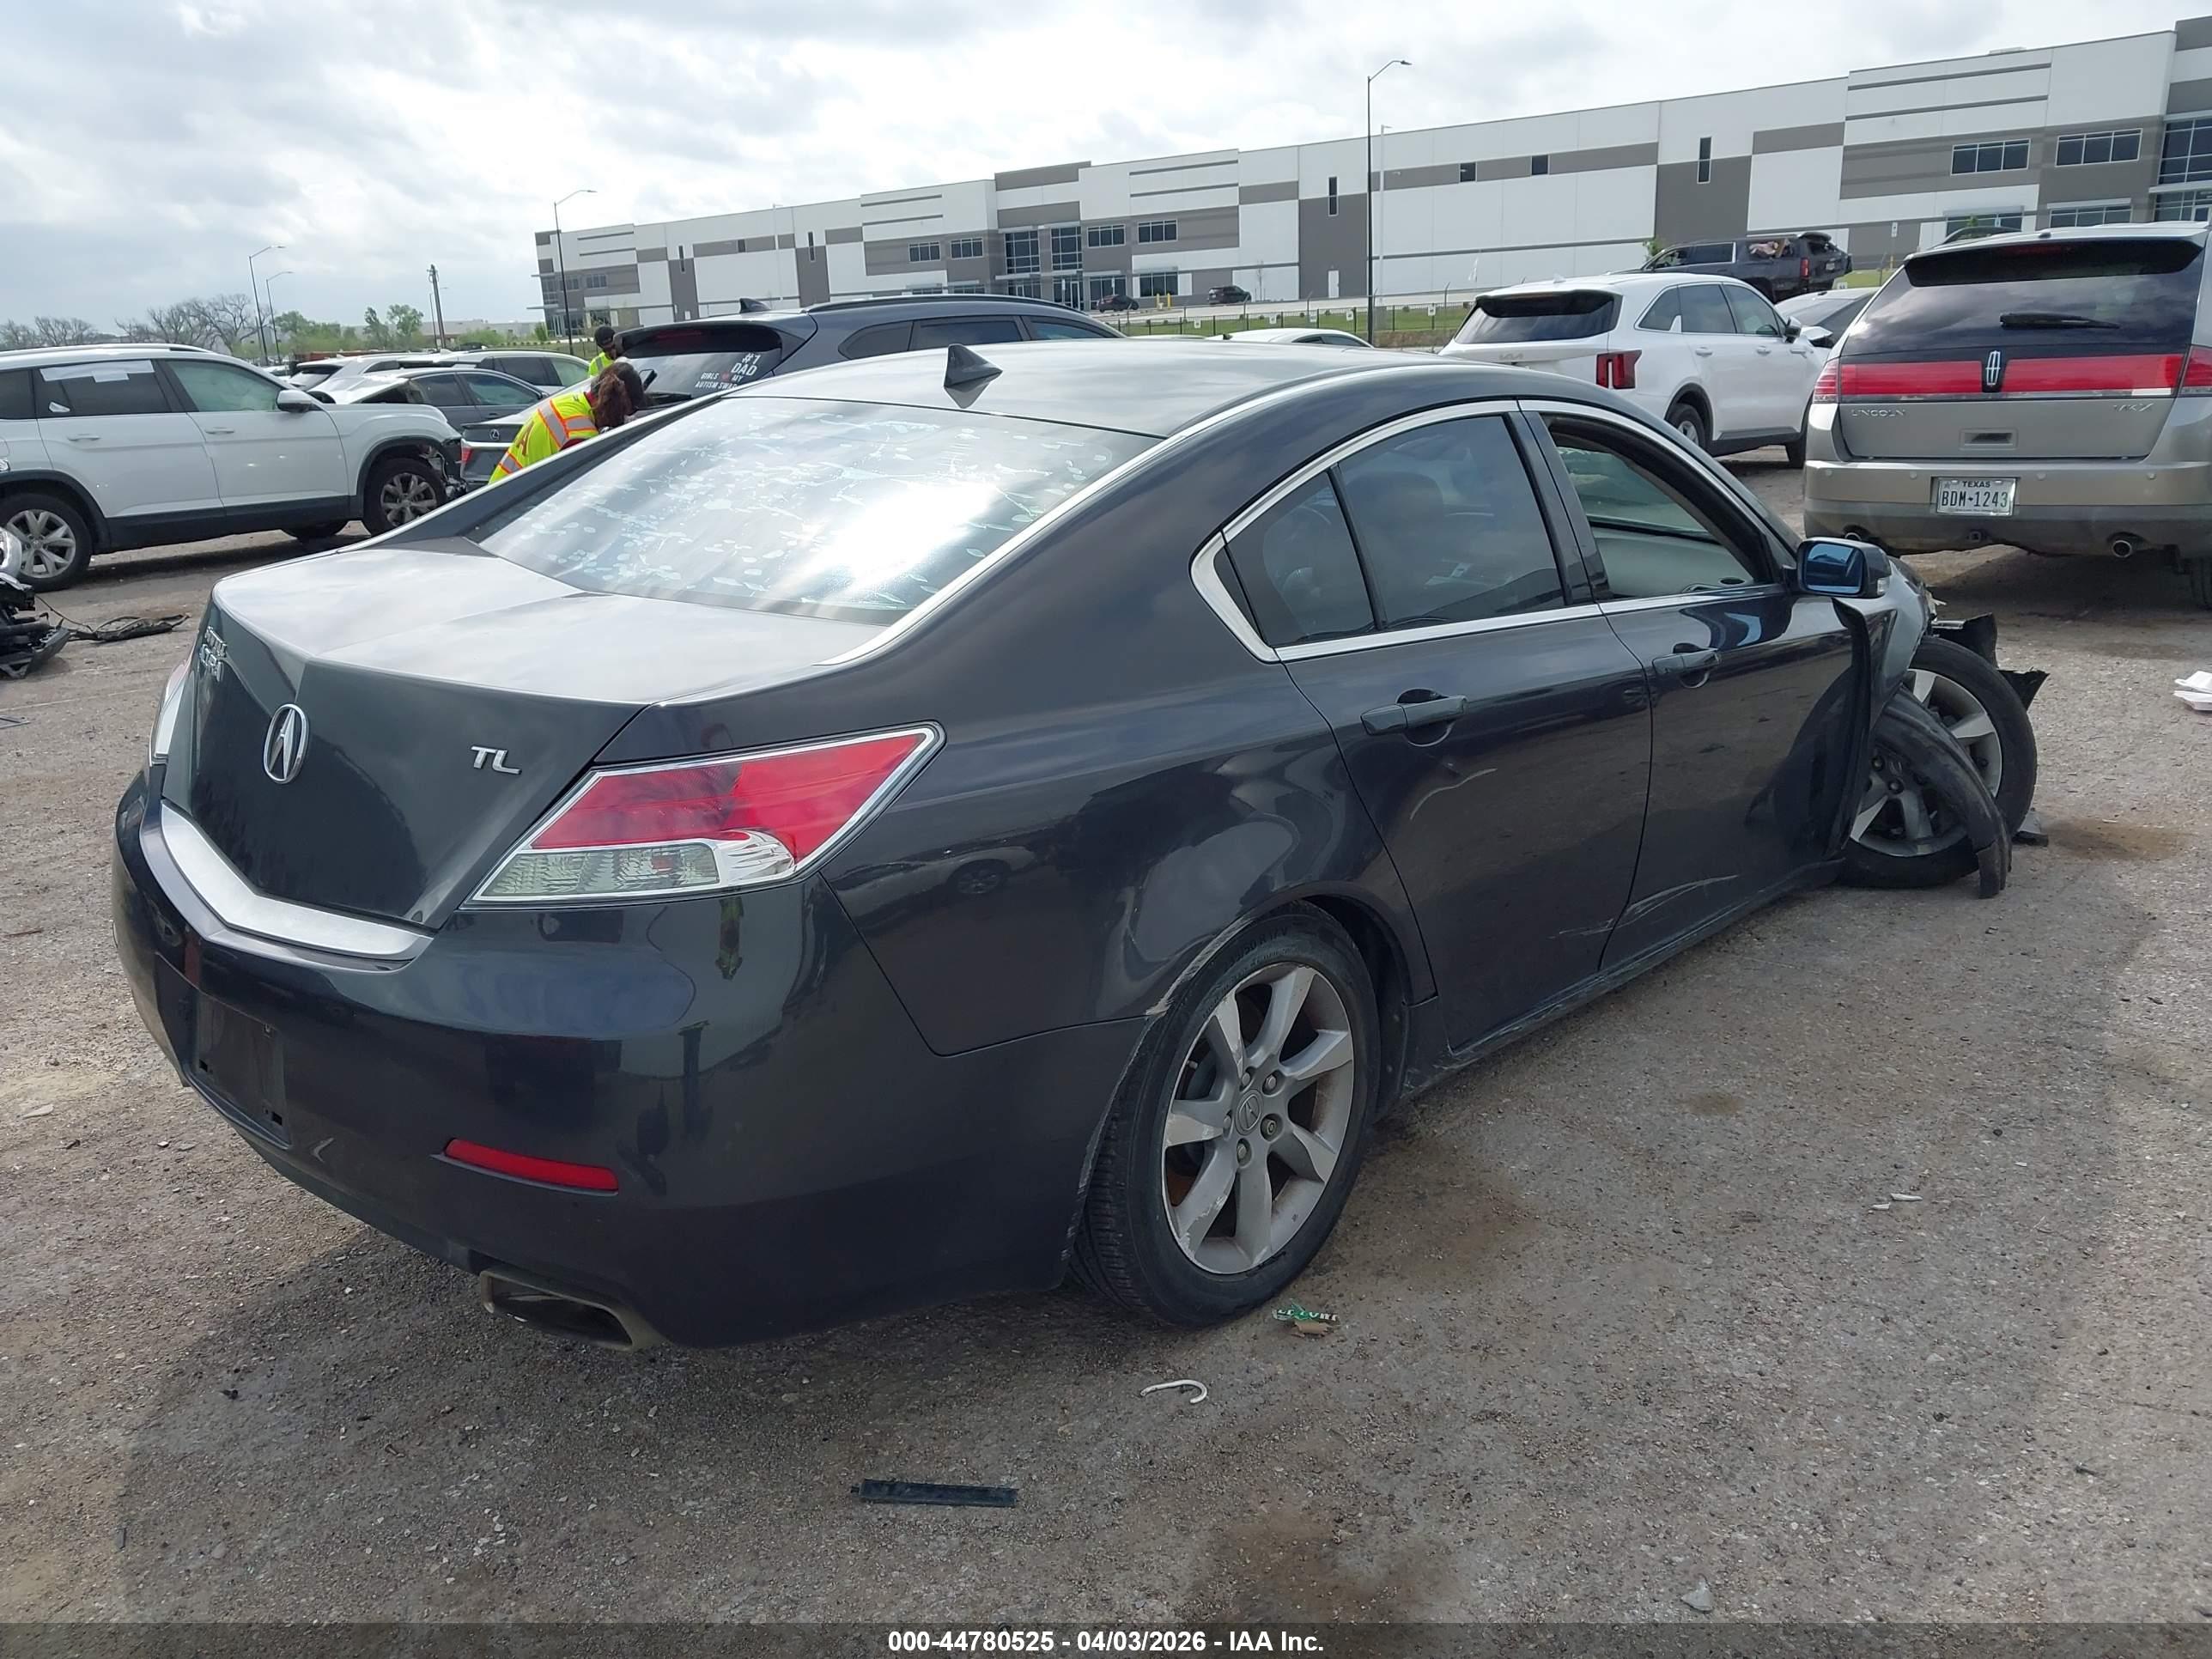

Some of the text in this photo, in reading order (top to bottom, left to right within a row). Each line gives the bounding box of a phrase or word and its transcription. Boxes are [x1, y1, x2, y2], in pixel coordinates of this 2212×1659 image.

[742, 353, 761, 365] #1
[731, 362, 757, 376] DAD
[470, 745, 522, 775] TL
